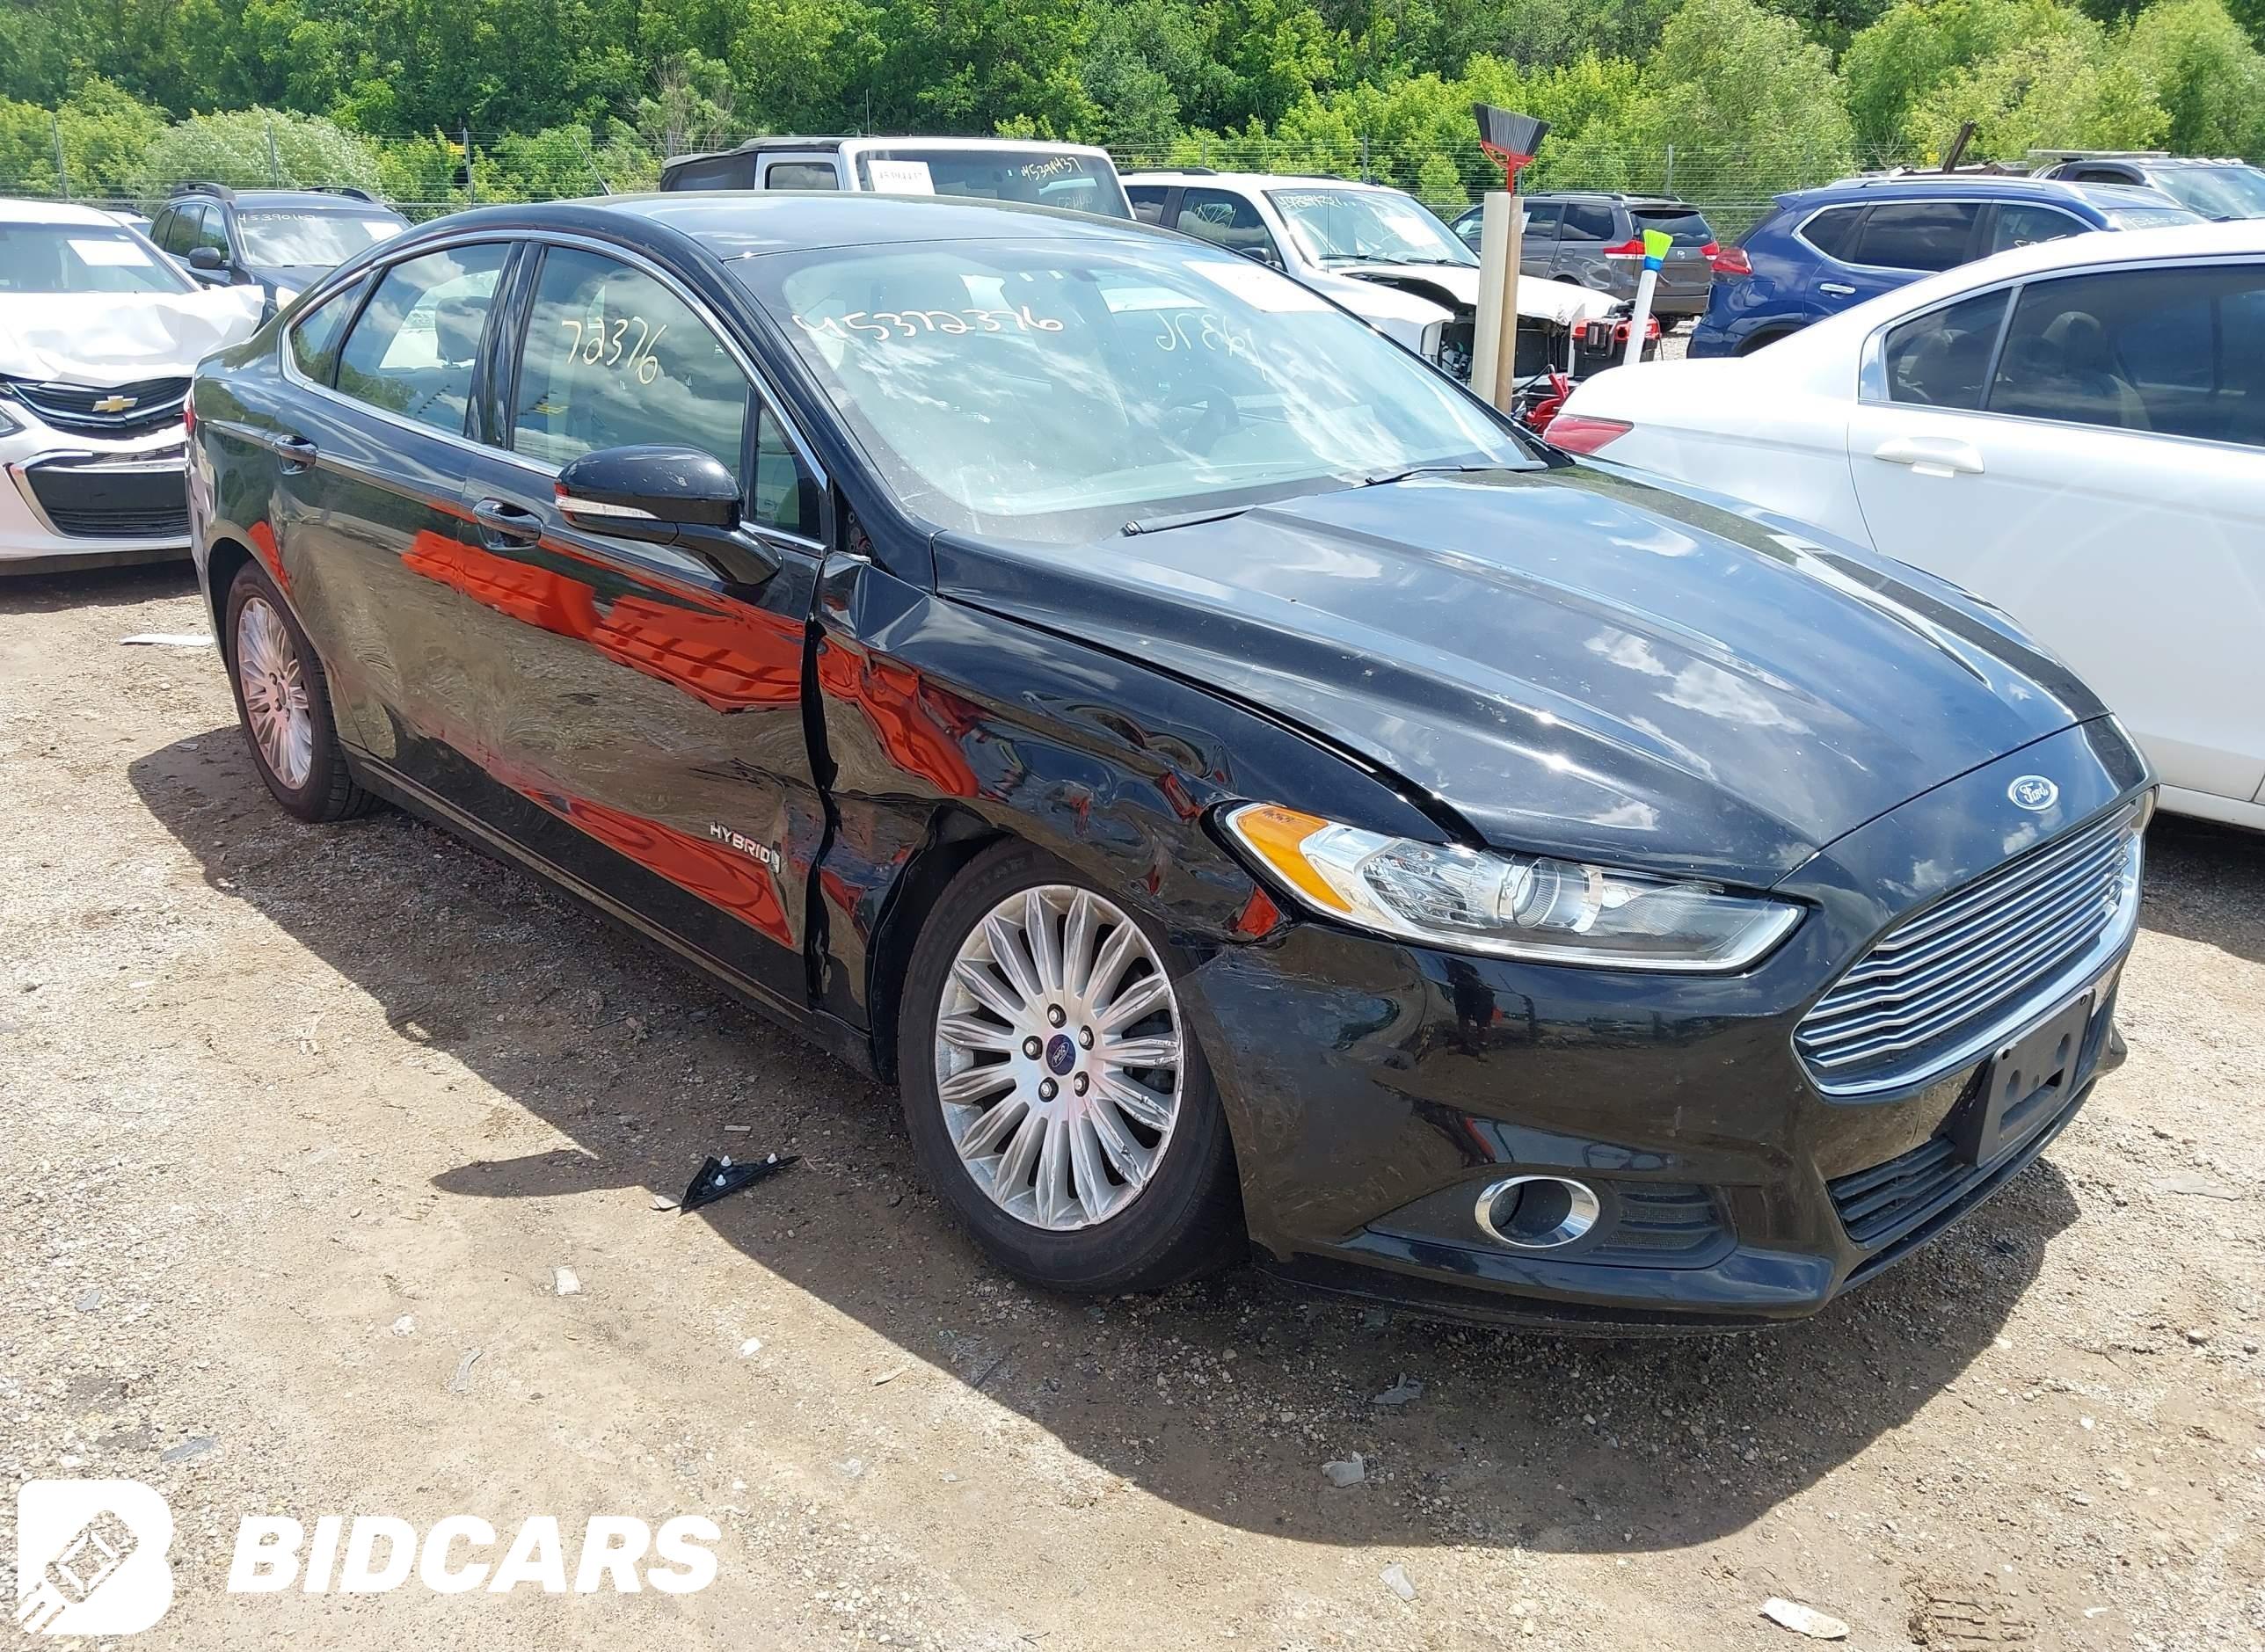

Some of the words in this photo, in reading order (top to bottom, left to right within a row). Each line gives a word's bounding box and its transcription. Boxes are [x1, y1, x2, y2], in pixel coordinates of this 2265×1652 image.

[791, 304, 1064, 340] 45372376
[561, 316, 667, 385] 72376
[2019, 782, 2049, 804] Ford
[710, 822, 771, 864] HYBRID
